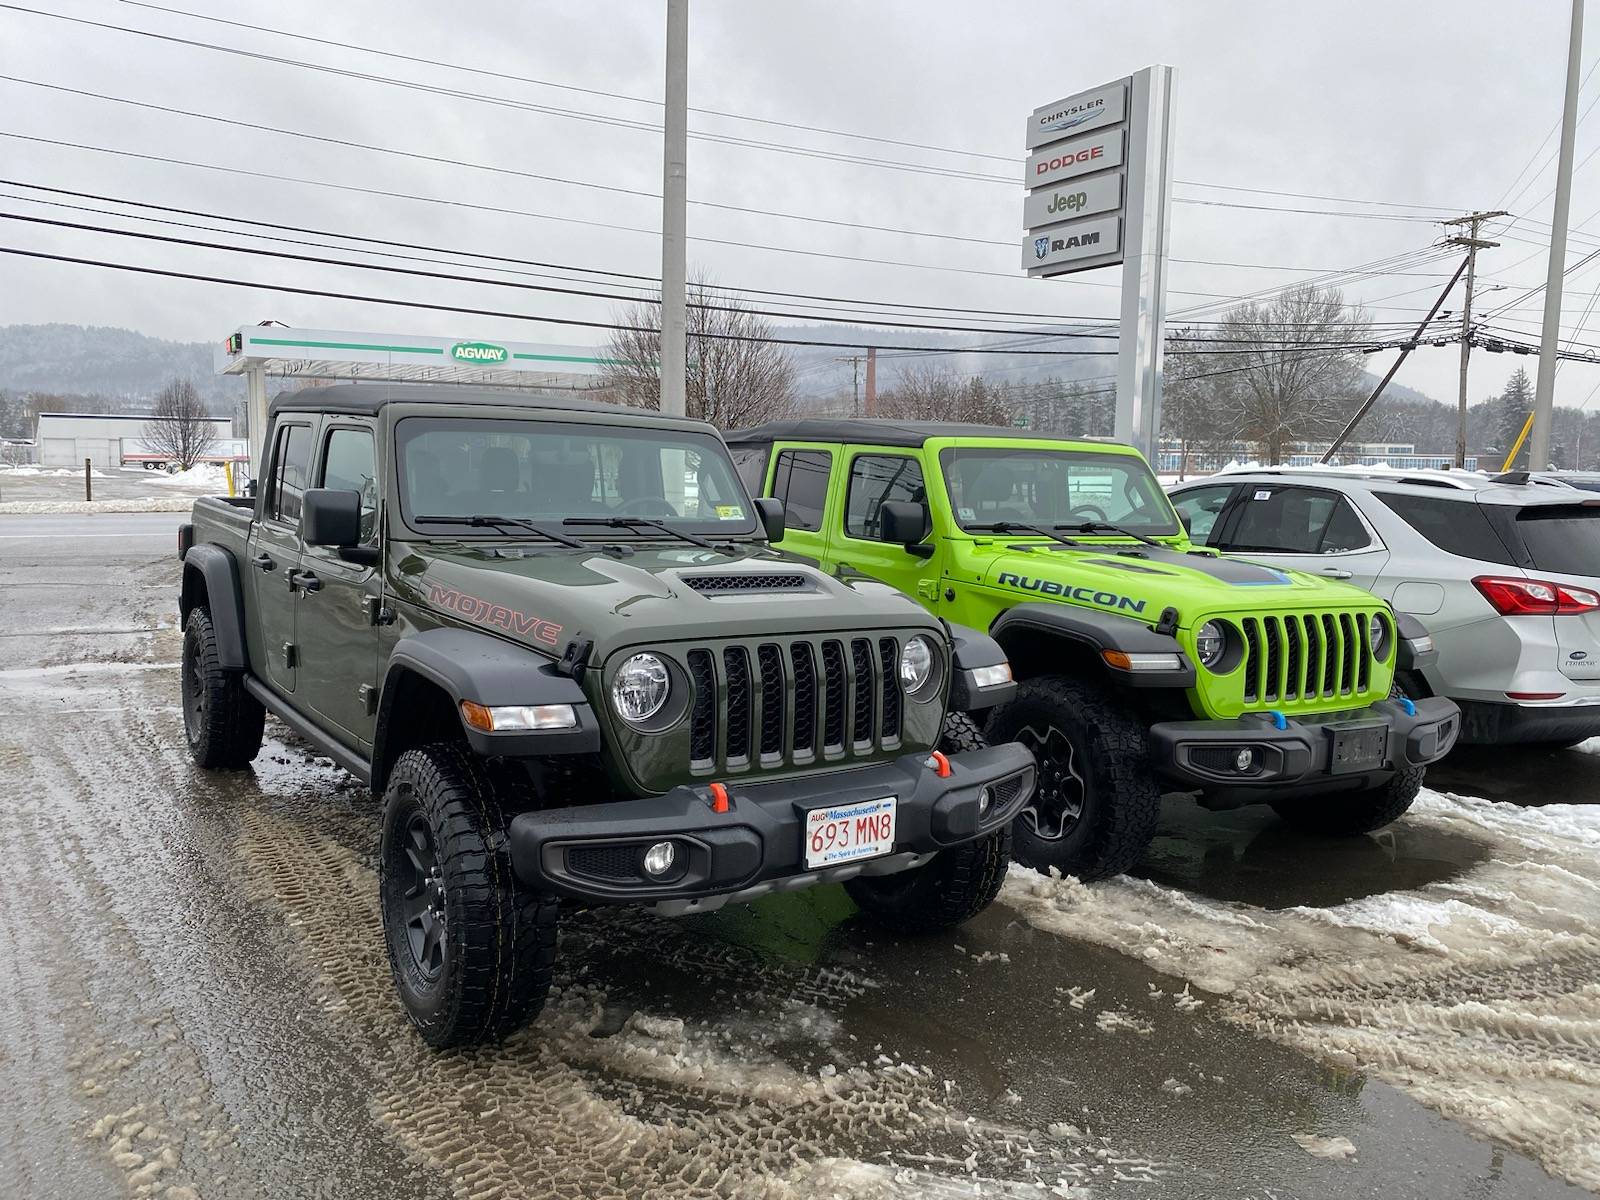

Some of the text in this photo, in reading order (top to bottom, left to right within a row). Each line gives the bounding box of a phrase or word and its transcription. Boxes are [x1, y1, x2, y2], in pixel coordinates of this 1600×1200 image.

[1040, 98, 1104, 125] CHRYSLER
[1036, 145, 1104, 175] DODGE
[1047, 191, 1087, 214] Jeep
[1051, 231, 1100, 252] RAM
[455, 346, 504, 361] AGWAY
[998, 572, 1146, 613] RUBICON
[428, 584, 563, 646] MOJAVE
[811, 813, 825, 823] AUG
[829, 805, 878, 820] Massachusetts
[811, 813, 891, 853] 693 MN8
